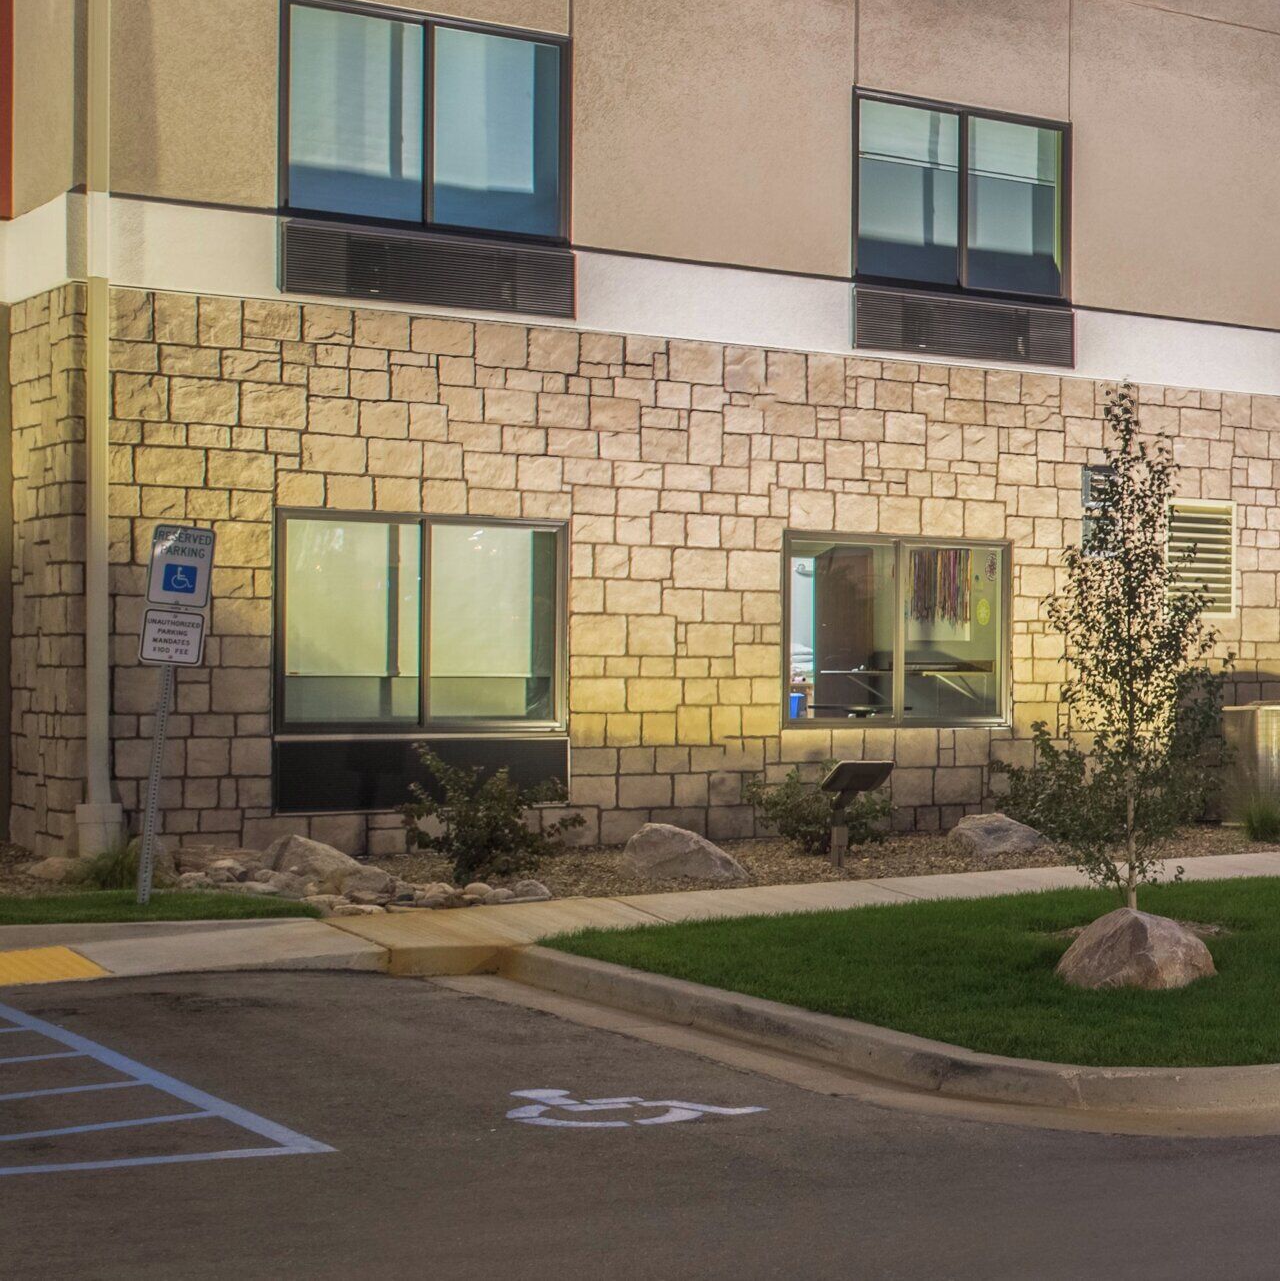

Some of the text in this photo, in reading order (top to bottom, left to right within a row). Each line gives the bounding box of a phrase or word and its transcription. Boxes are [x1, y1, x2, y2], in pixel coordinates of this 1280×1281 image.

[160, 544, 206, 559] PARKING
[147, 618, 201, 629] UNAUTHORIZED
[157, 628, 188, 637] PARKING
[152, 637, 191, 646] MANDATES
